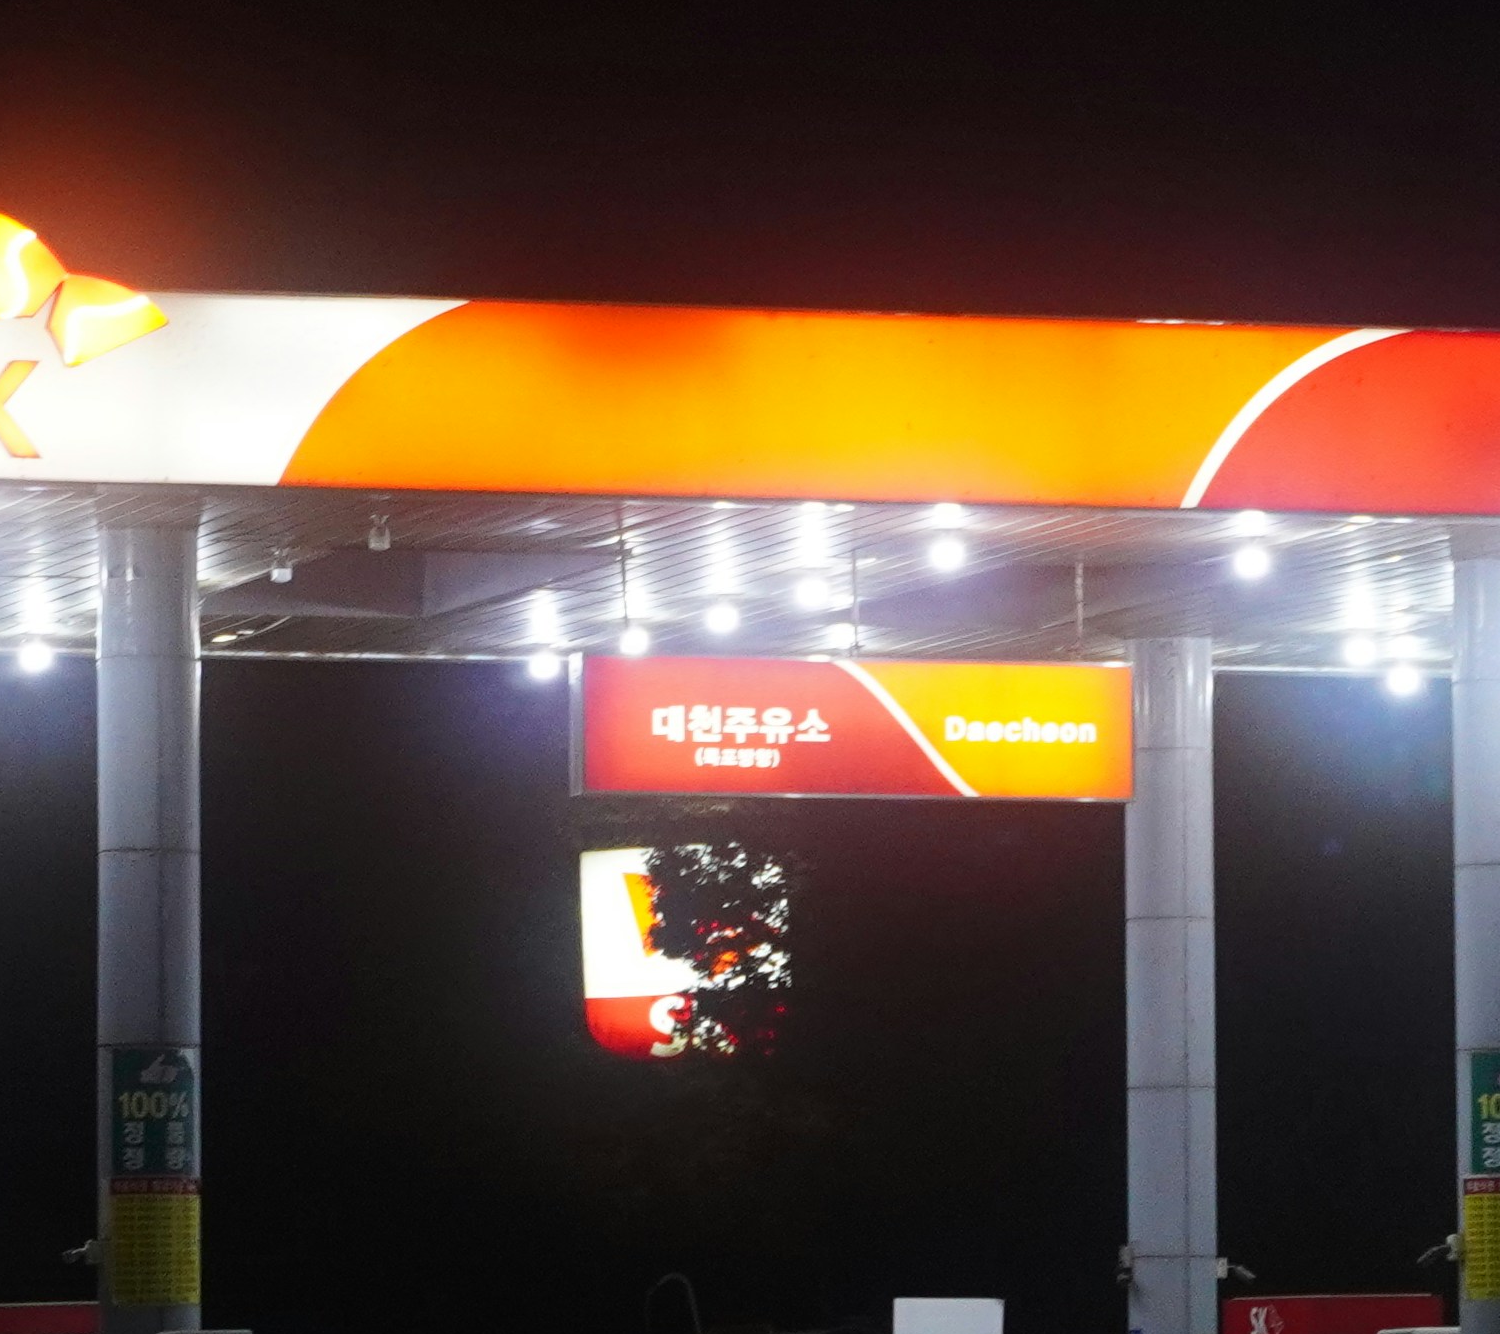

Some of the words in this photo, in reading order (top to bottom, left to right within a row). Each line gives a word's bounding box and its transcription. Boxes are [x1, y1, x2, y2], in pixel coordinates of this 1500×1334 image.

[651, 705, 831, 743] 대천주유소
[944, 715, 1097, 743] Daecheon
[118, 1091, 189, 1119] 100%
